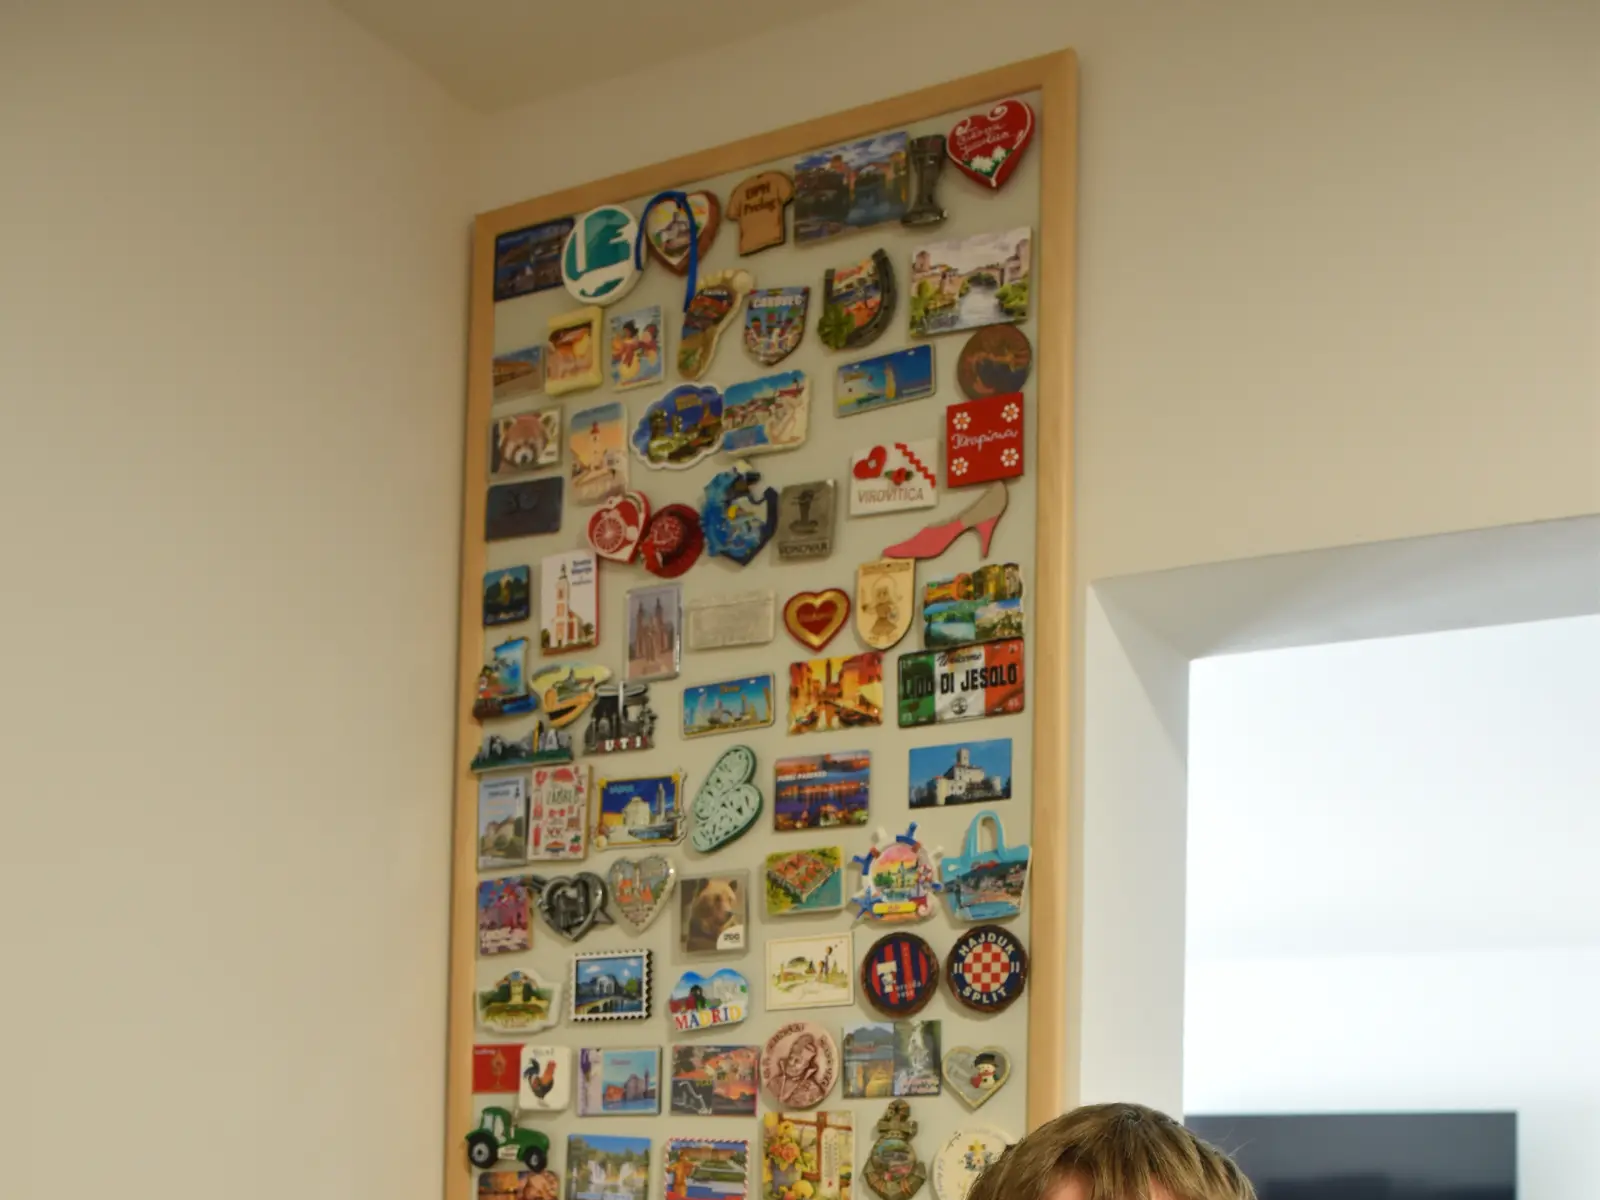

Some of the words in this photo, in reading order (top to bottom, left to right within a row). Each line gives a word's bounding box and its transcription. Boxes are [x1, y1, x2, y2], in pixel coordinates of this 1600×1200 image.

[857, 486, 924, 504] VIROVITICA
[940, 671, 955, 695] DI
[960, 662, 1018, 692] JESOLO
[958, 931, 1015, 957] HAJDUK
[962, 986, 1007, 1005] SPLIT
[675, 1006, 742, 1031] MADRID
